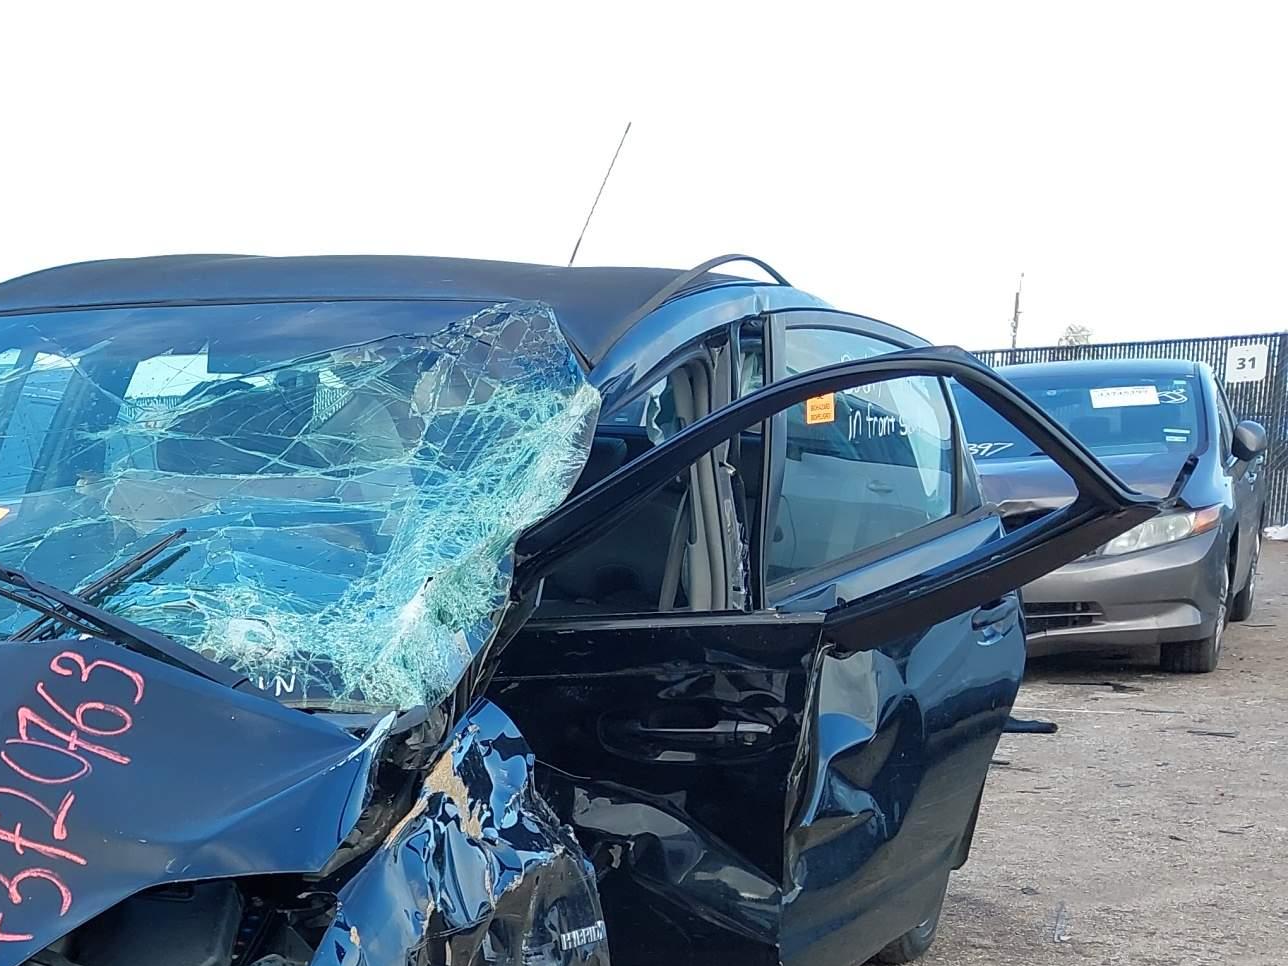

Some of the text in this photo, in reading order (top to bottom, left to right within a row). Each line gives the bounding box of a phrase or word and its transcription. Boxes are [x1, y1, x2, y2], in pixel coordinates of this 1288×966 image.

[1235, 356, 1256, 370] 31
[848, 407, 862, 441] in
[865, 402, 896, 439] front
